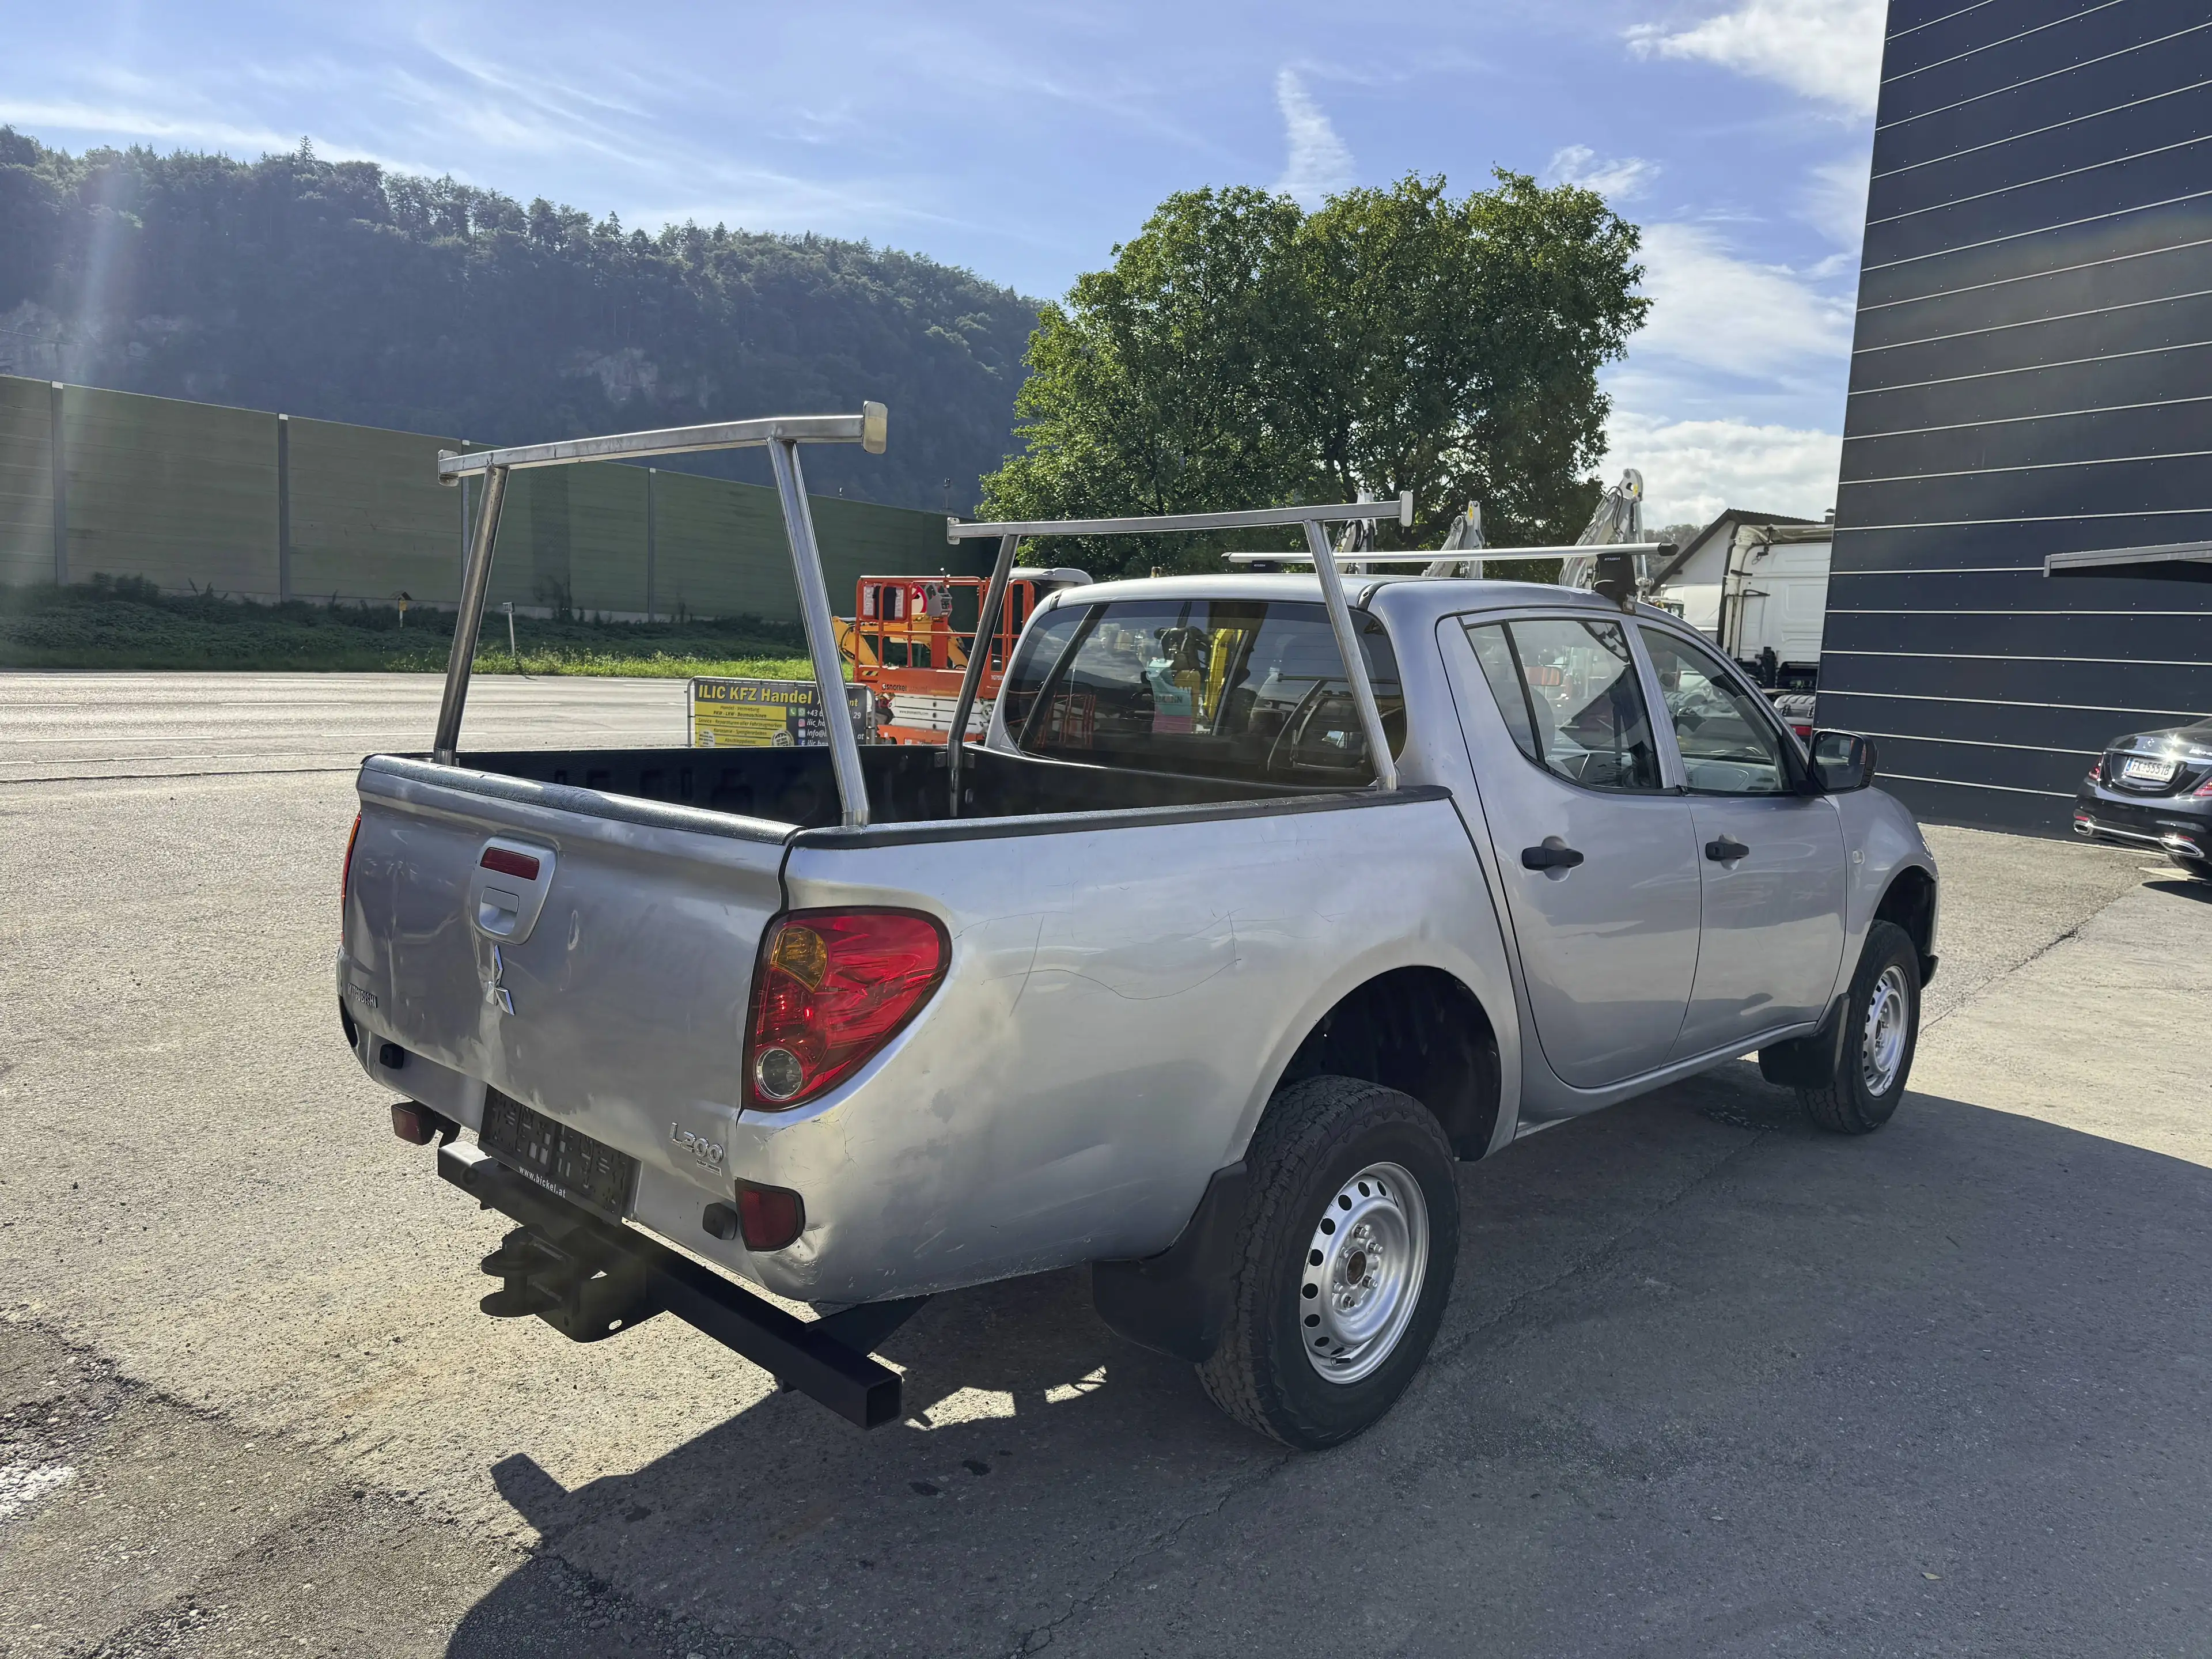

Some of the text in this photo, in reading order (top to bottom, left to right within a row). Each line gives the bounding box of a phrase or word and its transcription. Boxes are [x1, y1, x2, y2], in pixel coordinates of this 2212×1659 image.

[699, 685, 726, 699] ILIC
[730, 687, 758, 701] KFZ
[760, 688, 812, 704] Handel
[348, 982, 378, 1009] MITSUBISHI
[669, 1122, 724, 1164] L200
